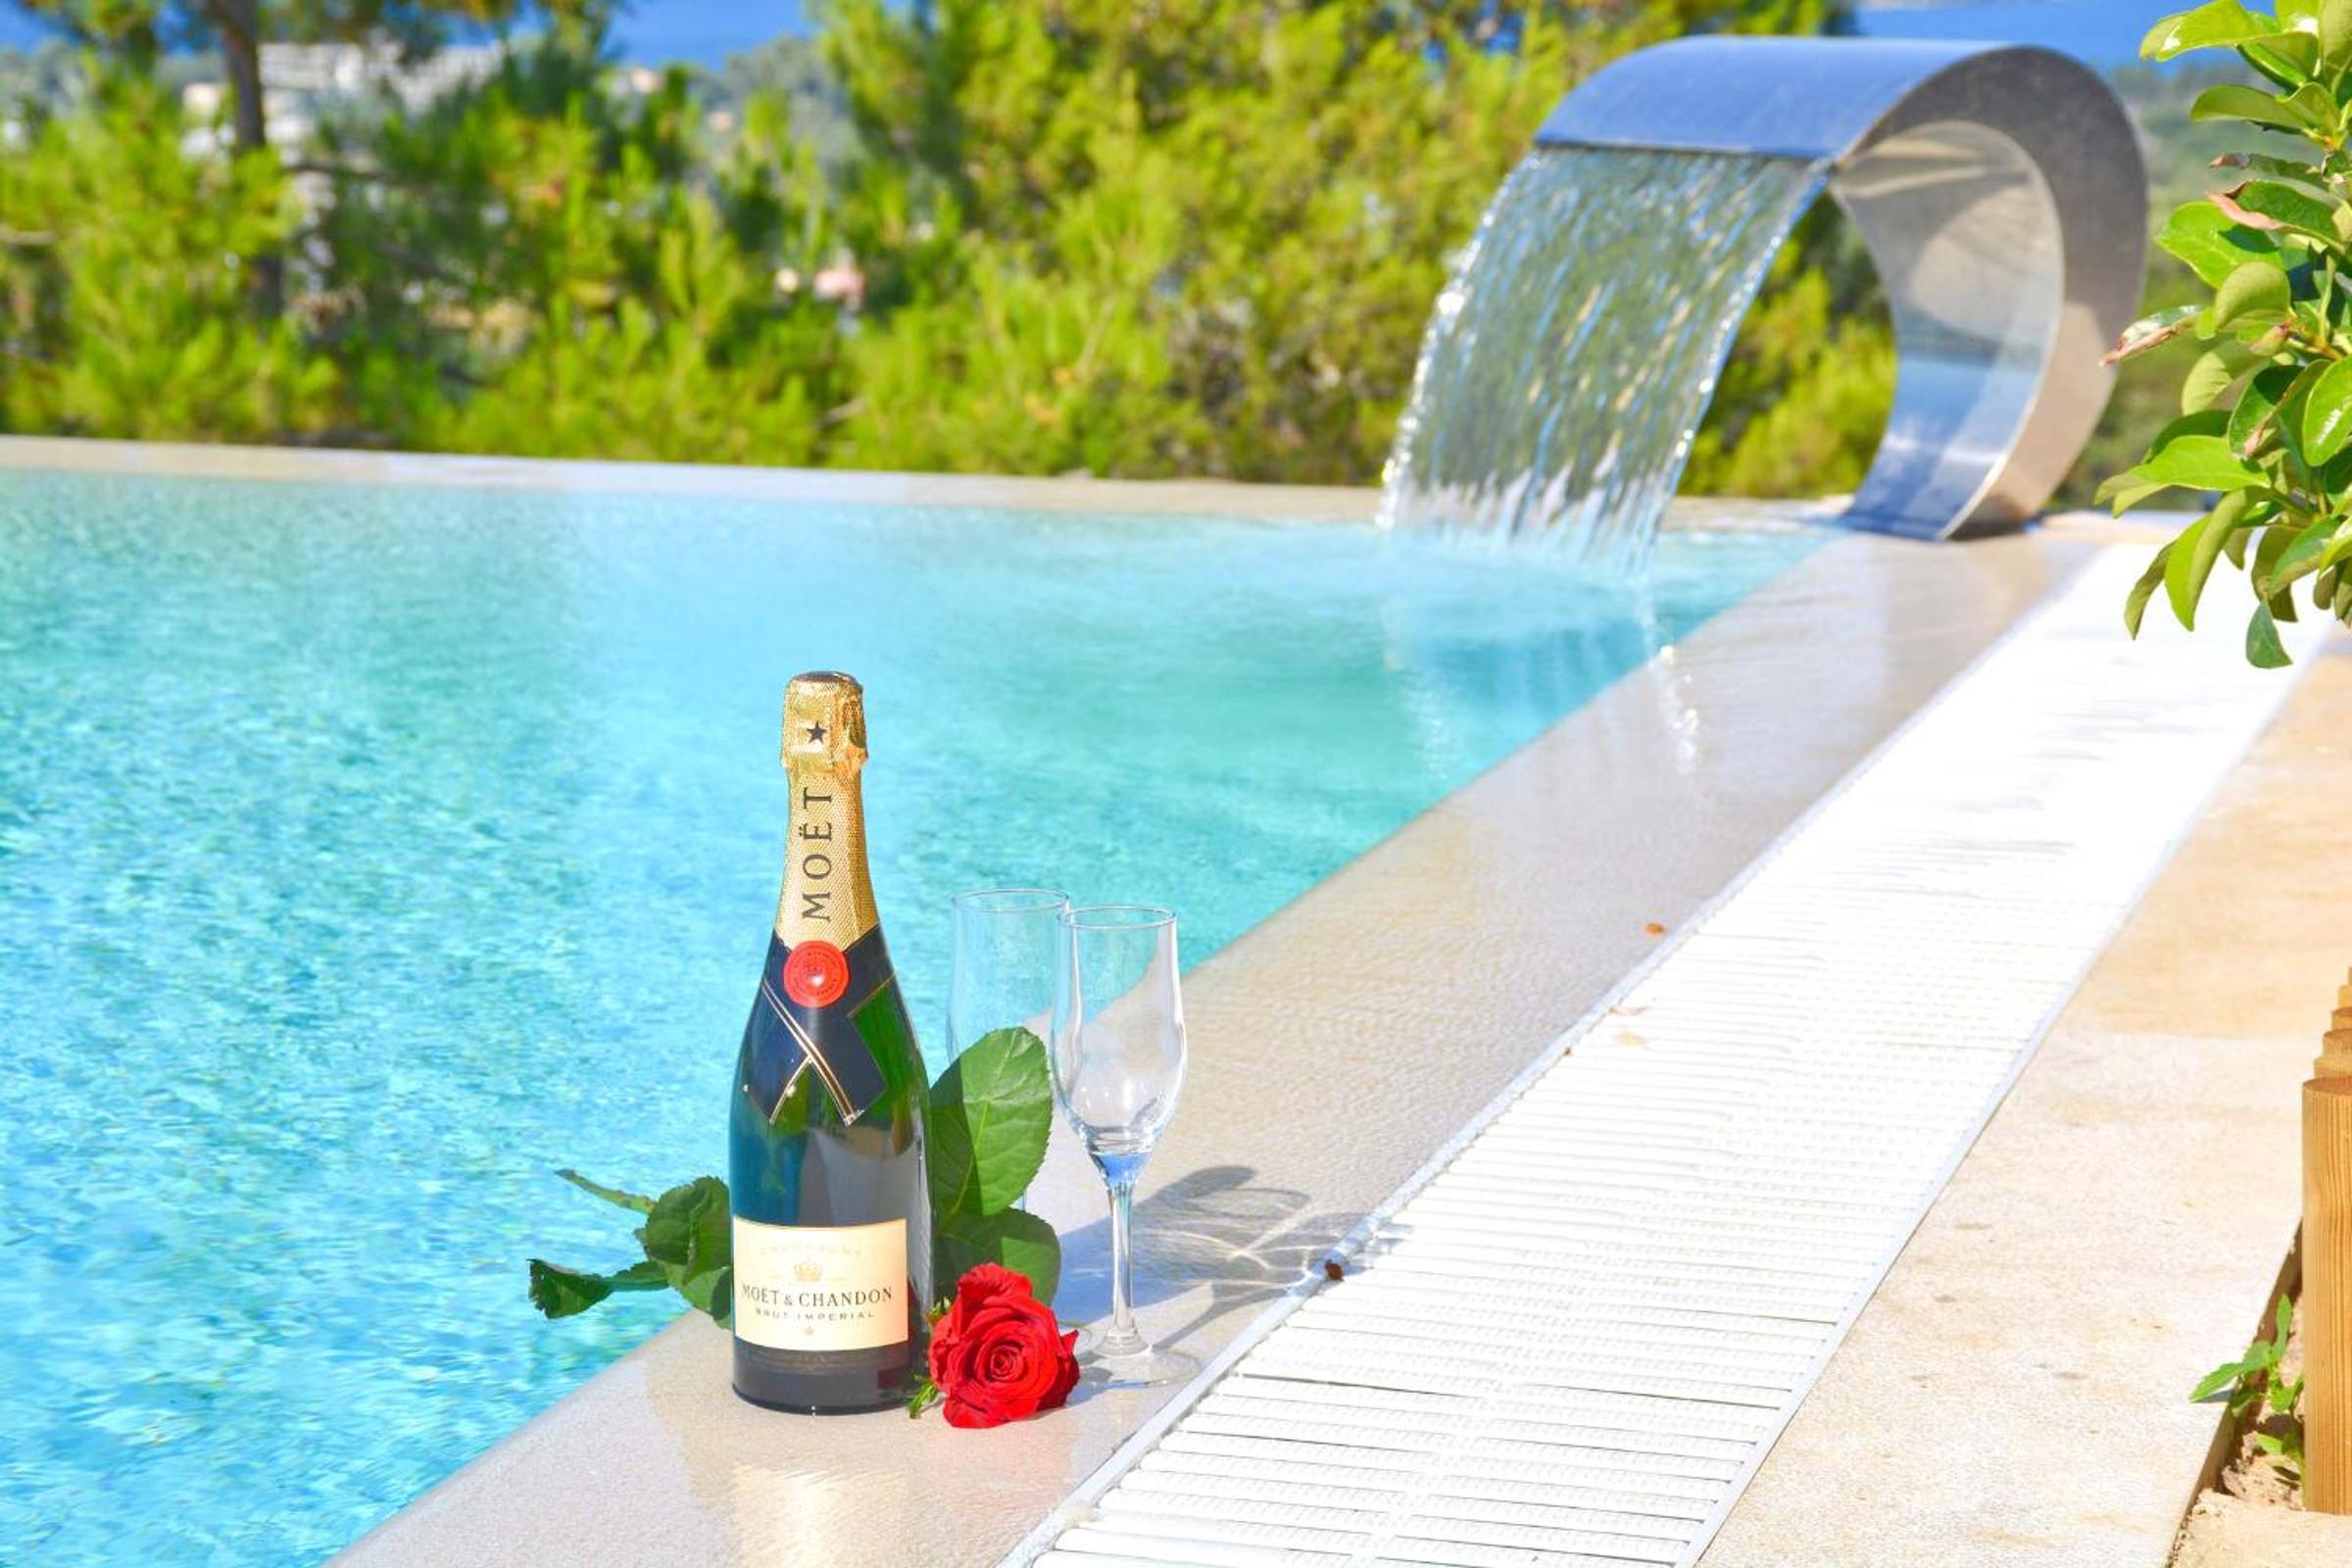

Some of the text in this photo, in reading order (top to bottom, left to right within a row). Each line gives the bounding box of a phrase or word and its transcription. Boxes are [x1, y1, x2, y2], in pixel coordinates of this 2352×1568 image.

[799, 786, 833, 922] MOËT
[784, 1294, 794, 1306] &
[799, 1286, 893, 1307] CHANDON
